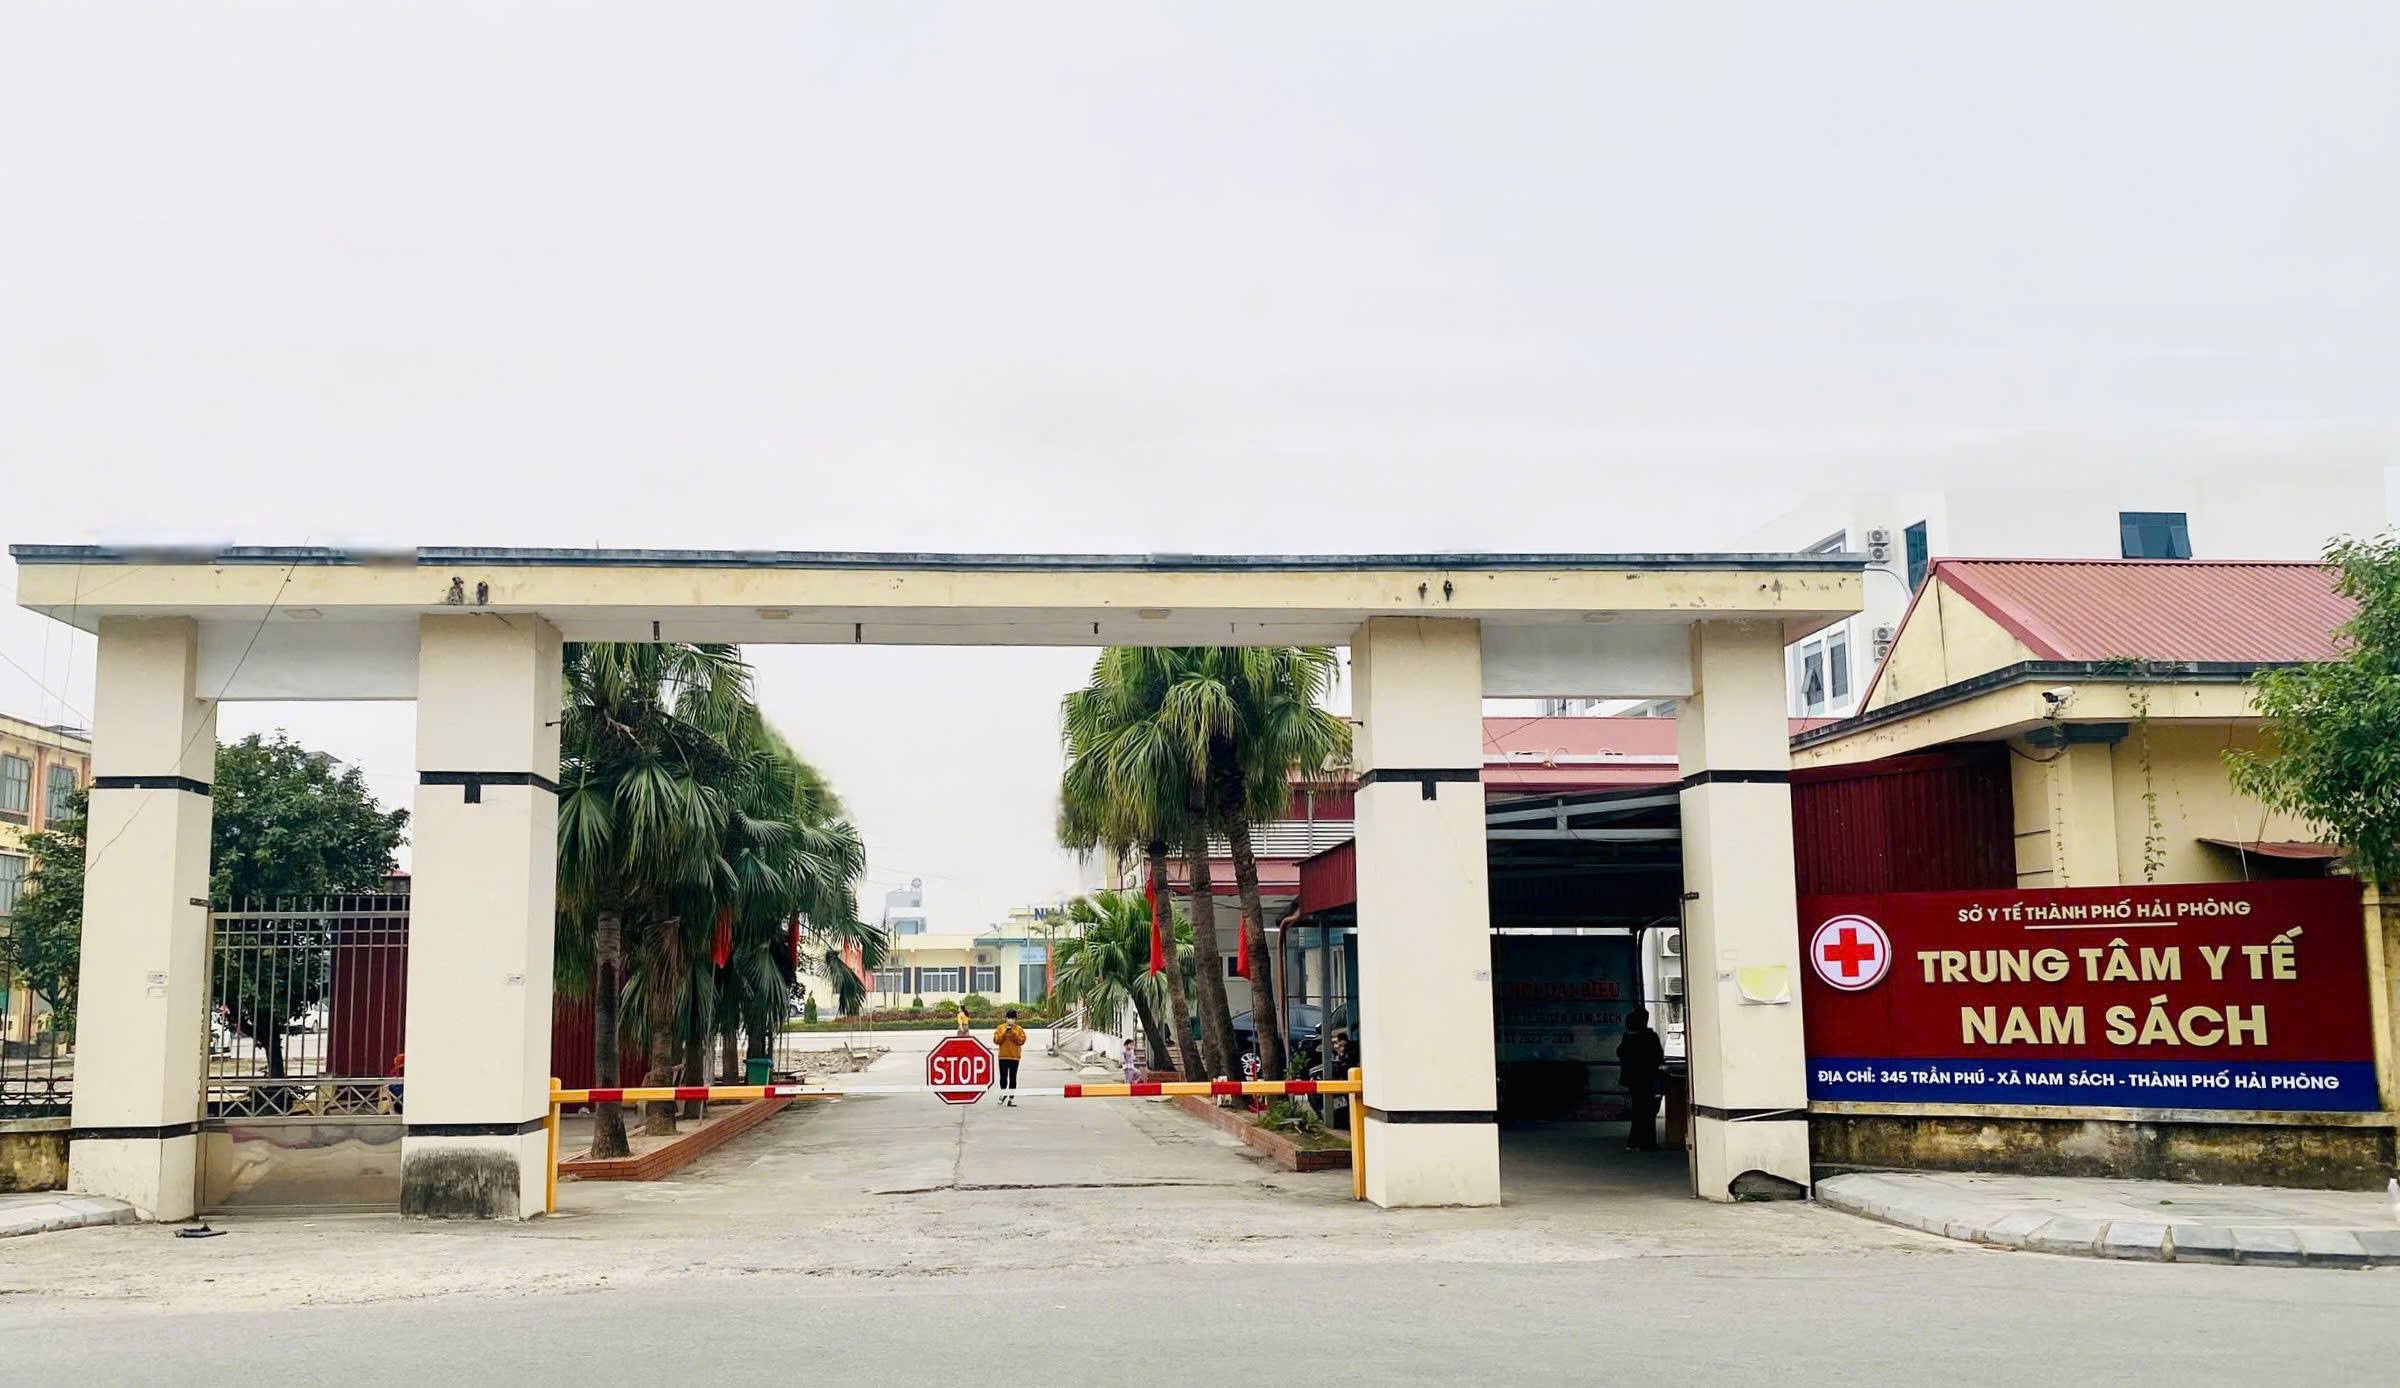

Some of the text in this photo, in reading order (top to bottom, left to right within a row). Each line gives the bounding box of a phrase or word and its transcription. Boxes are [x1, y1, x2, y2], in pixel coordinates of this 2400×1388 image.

[1958, 897, 2251, 923] SỞ Y TẾ THÀNH PHỐ HẢI PHÒNG
[1917, 926, 2303, 983] TRUNG TÂM Y TẾ
[1961, 993, 2268, 1047] NAM SÁCH
[933, 1056, 986, 1085] STOP
[1817, 1070, 1844, 1085] ĐỊA
[1845, 1066, 1876, 1083] CHỈ:
[1880, 1070, 1908, 1084] 345
[1910, 1065, 1951, 1084] TRẦN
[1953, 1068, 1985, 1085] PHÚ
[1996, 1069, 2022, 1085] XÃ
[2025, 1072, 2064, 1086] NAM
[2068, 1069, 2115, 1086] SÁCH
[2128, 1070, 2188, 1088] THÀNH
[2191, 1069, 2230, 1089] PHỐ
[2234, 1071, 2267, 1089] HẢI
[2270, 1072, 2340, 1090] PHÒNG
